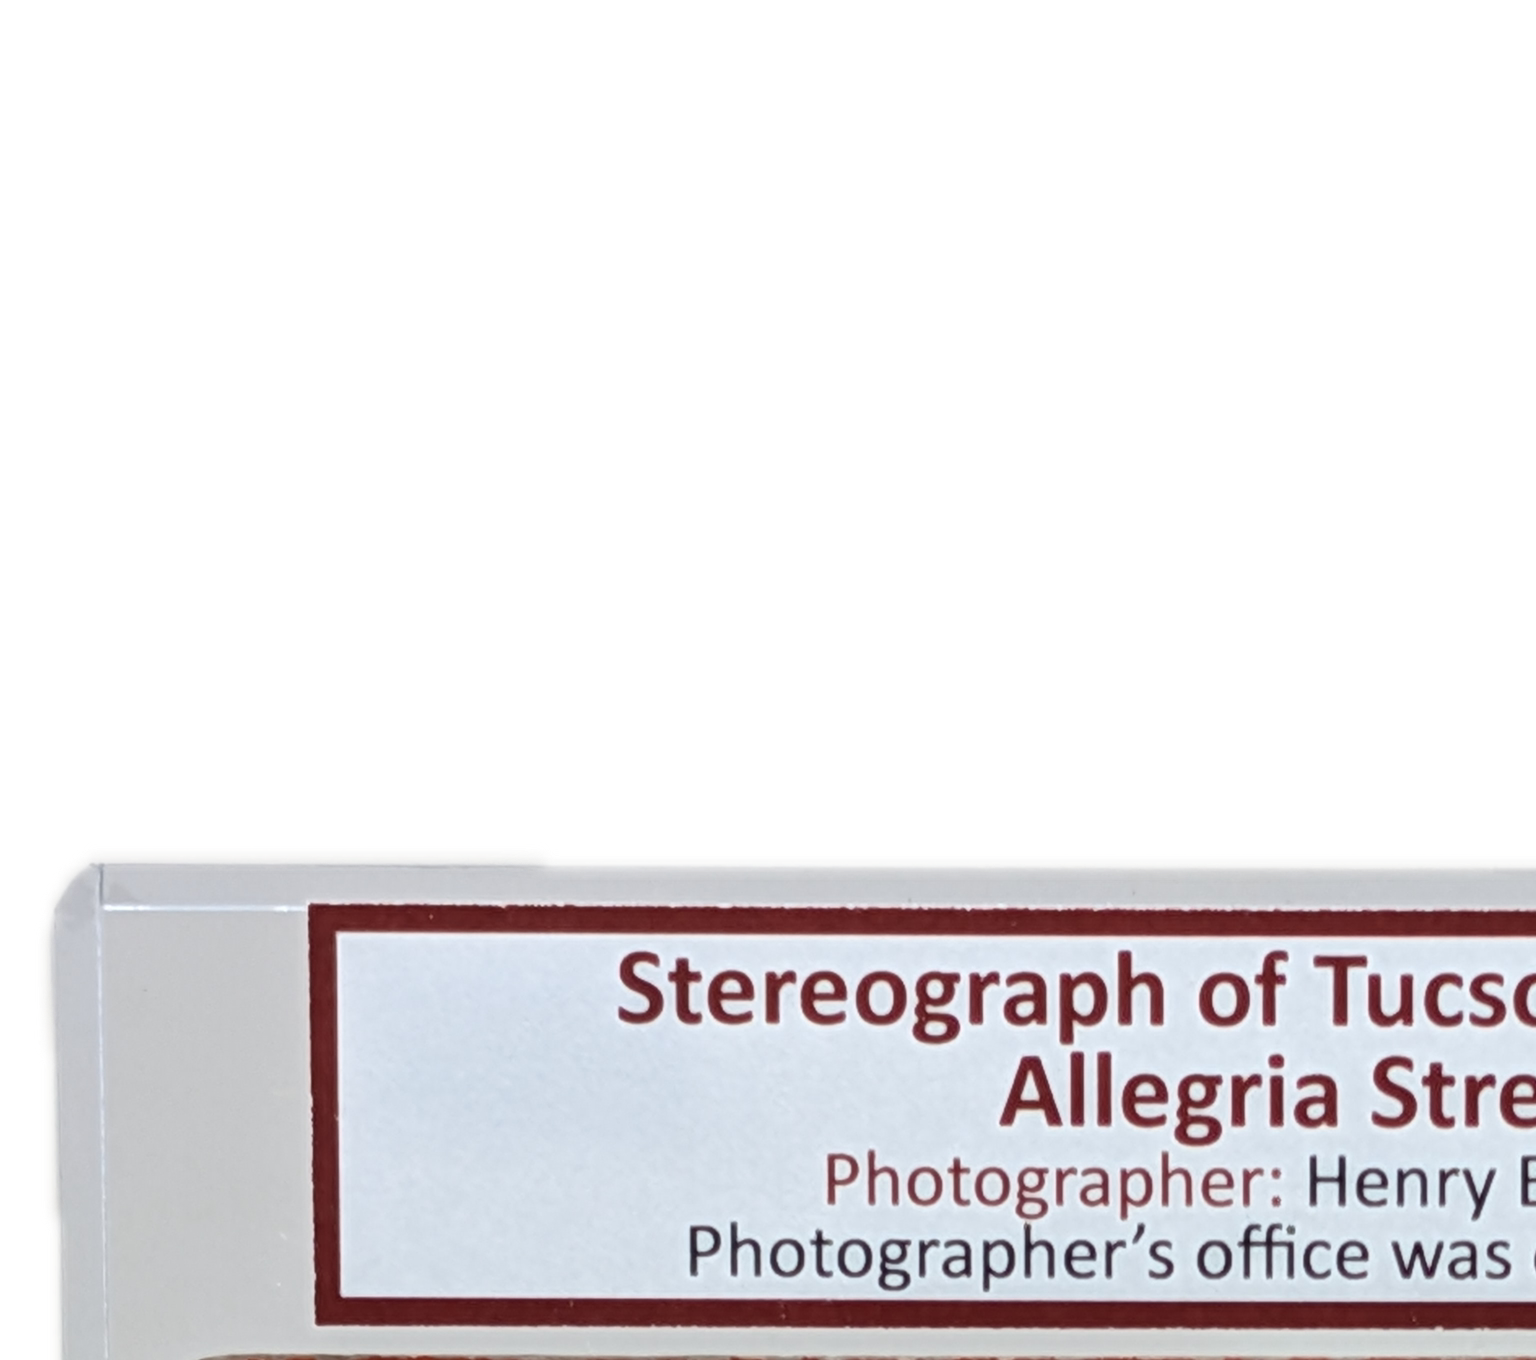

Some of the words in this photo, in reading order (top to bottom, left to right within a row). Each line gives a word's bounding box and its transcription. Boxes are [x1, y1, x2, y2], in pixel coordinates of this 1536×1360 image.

[618, 949, 1165, 1046] Stereograph
[1198, 949, 1289, 1027] of
[999, 1051, 1338, 1147] Allegria
[827, 1149, 1282, 1221] Photographer:
[1309, 1154, 1497, 1221] Henry
[689, 1221, 1175, 1293] Photographer’s
[1196, 1223, 1369, 1280] office
[1391, 1240, 1512, 1281] was
